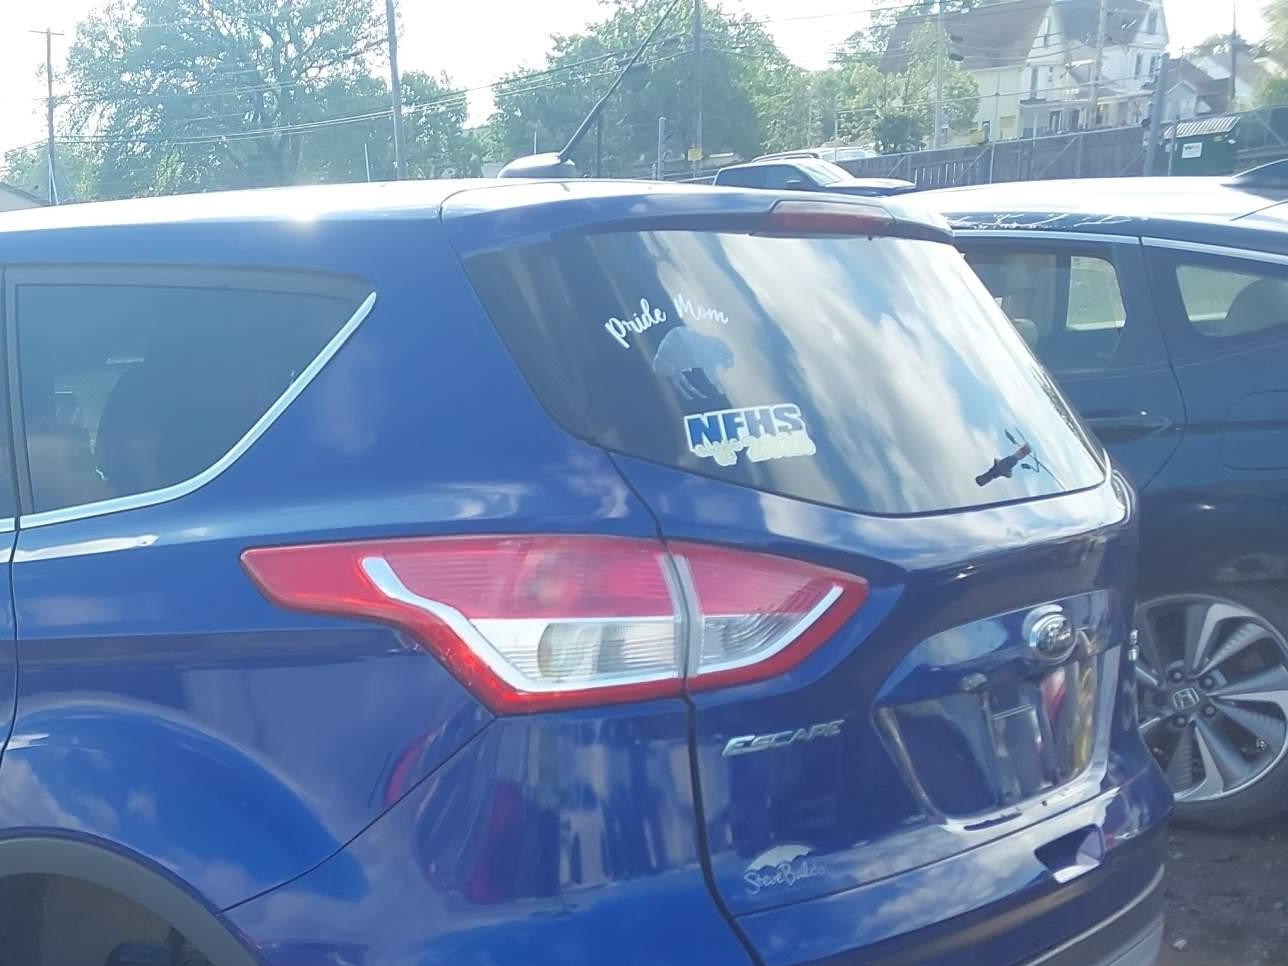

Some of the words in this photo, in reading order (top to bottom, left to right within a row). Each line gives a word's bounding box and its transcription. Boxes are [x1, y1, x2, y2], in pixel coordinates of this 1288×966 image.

[673, 293, 729, 324] Mom
[686, 405, 806, 449] NFHS
[721, 719, 845, 757] ESCAPE
